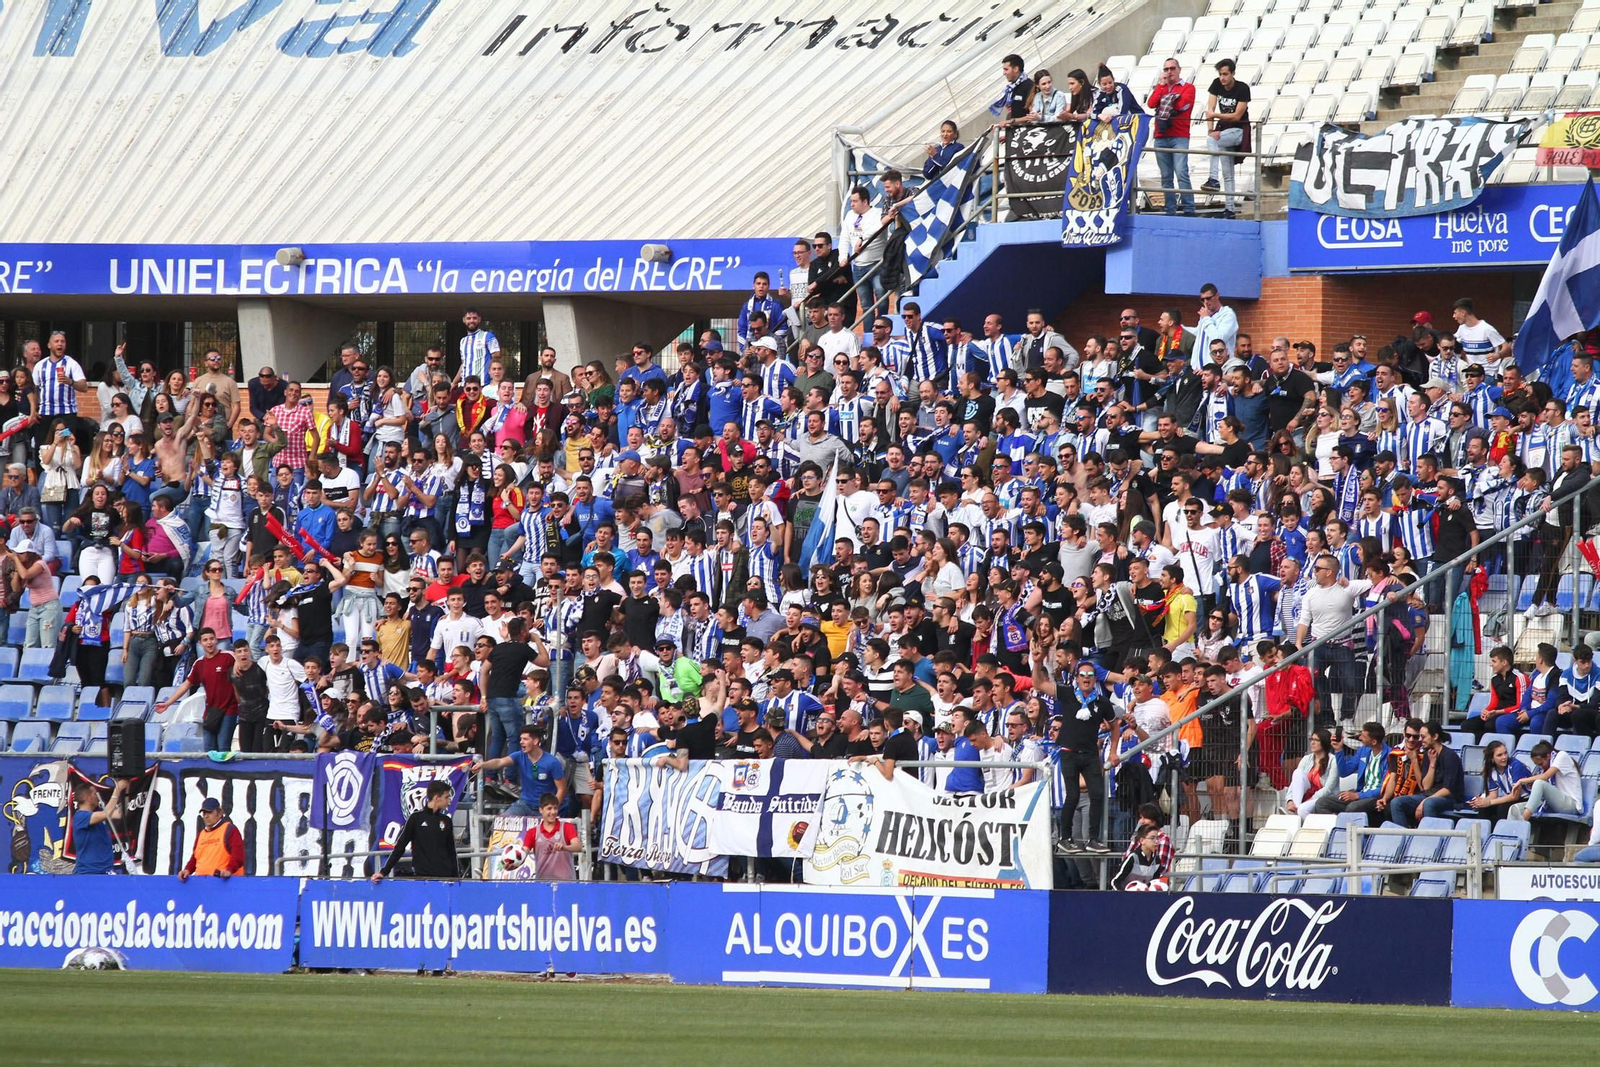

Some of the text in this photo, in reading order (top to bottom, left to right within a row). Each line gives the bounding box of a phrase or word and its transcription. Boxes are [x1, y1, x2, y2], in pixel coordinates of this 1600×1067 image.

[1316, 205, 1509, 249] CEOSA Huelva
[1451, 238, 1510, 257] me pone
[108, 257, 408, 295] UNIELECTRICA
[470, 257, 574, 293] energía
[583, 257, 621, 291] del
[400, 765, 458, 782] NEW
[32, 788, 62, 800] FRENTE
[602, 836, 644, 859] Forza
[1531, 874, 1600, 889] AUTOESCU
[725, 895, 990, 978] ALQUIBOXES
[1145, 895, 1348, 991] Coca-Cola
